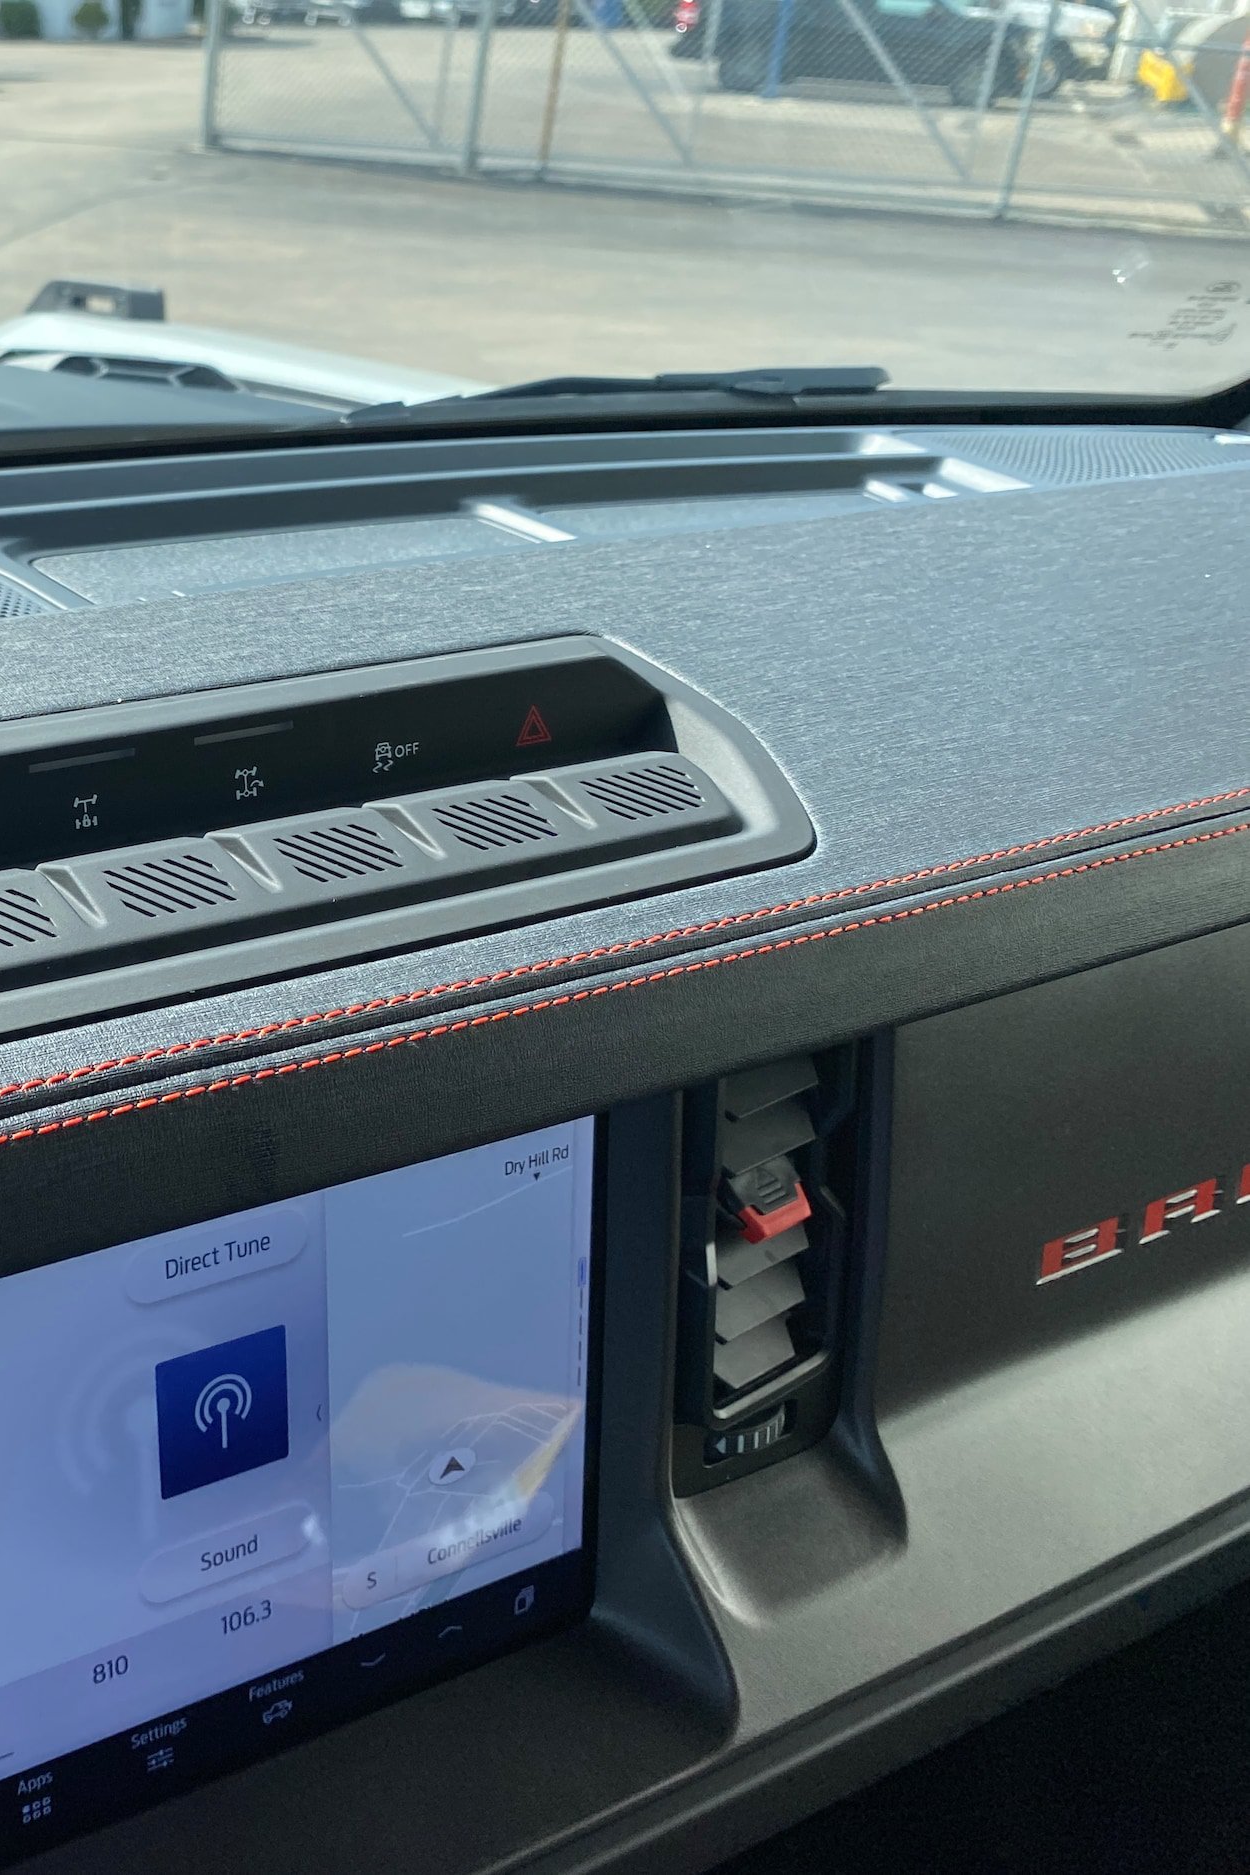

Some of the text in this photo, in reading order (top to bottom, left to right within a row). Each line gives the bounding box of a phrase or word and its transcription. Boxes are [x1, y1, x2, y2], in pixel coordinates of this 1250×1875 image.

[394, 742, 420, 758] OFF
[504, 1144, 570, 1175] Dry Hill Rd
[1036, 1163, 1250, 1285] BR
[165, 1235, 271, 1280] Direct Tune
[200, 1534, 258, 1572] Sound
[366, 1571, 378, 1590] S
[220, 1599, 272, 1635] 106.3
[92, 1654, 130, 1685] 810
[249, 1669, 305, 1702] Features
[131, 1716, 189, 1750] Settings
[17, 1771, 54, 1796] Apps
